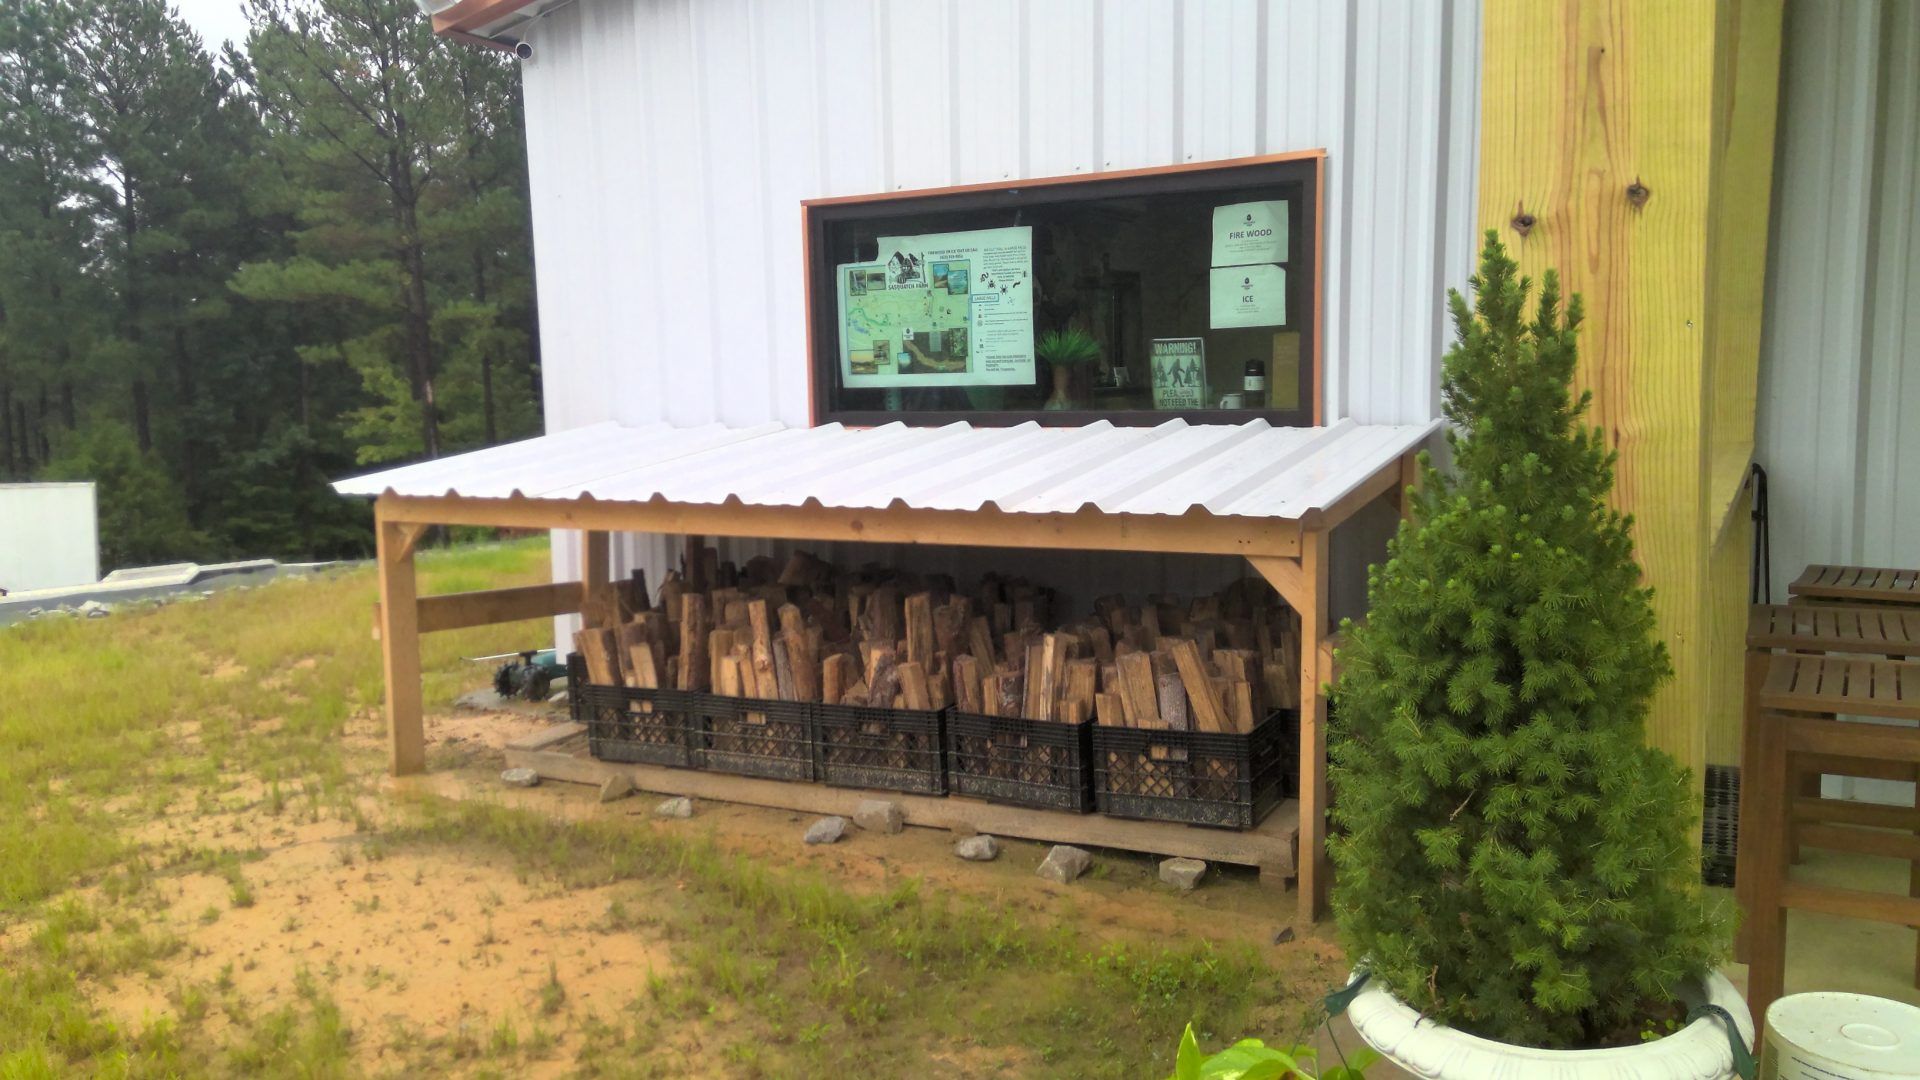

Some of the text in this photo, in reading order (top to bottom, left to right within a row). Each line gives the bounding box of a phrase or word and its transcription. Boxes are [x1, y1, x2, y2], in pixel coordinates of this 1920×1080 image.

[1229, 228, 1273, 240] FIRE WOOD
[888, 283, 915, 291] SASQUATCH
[1242, 295, 1254, 303] ICE
[1155, 342, 1196, 355] WARNING!
[1159, 398, 1199, 407] NOT FEED THE
